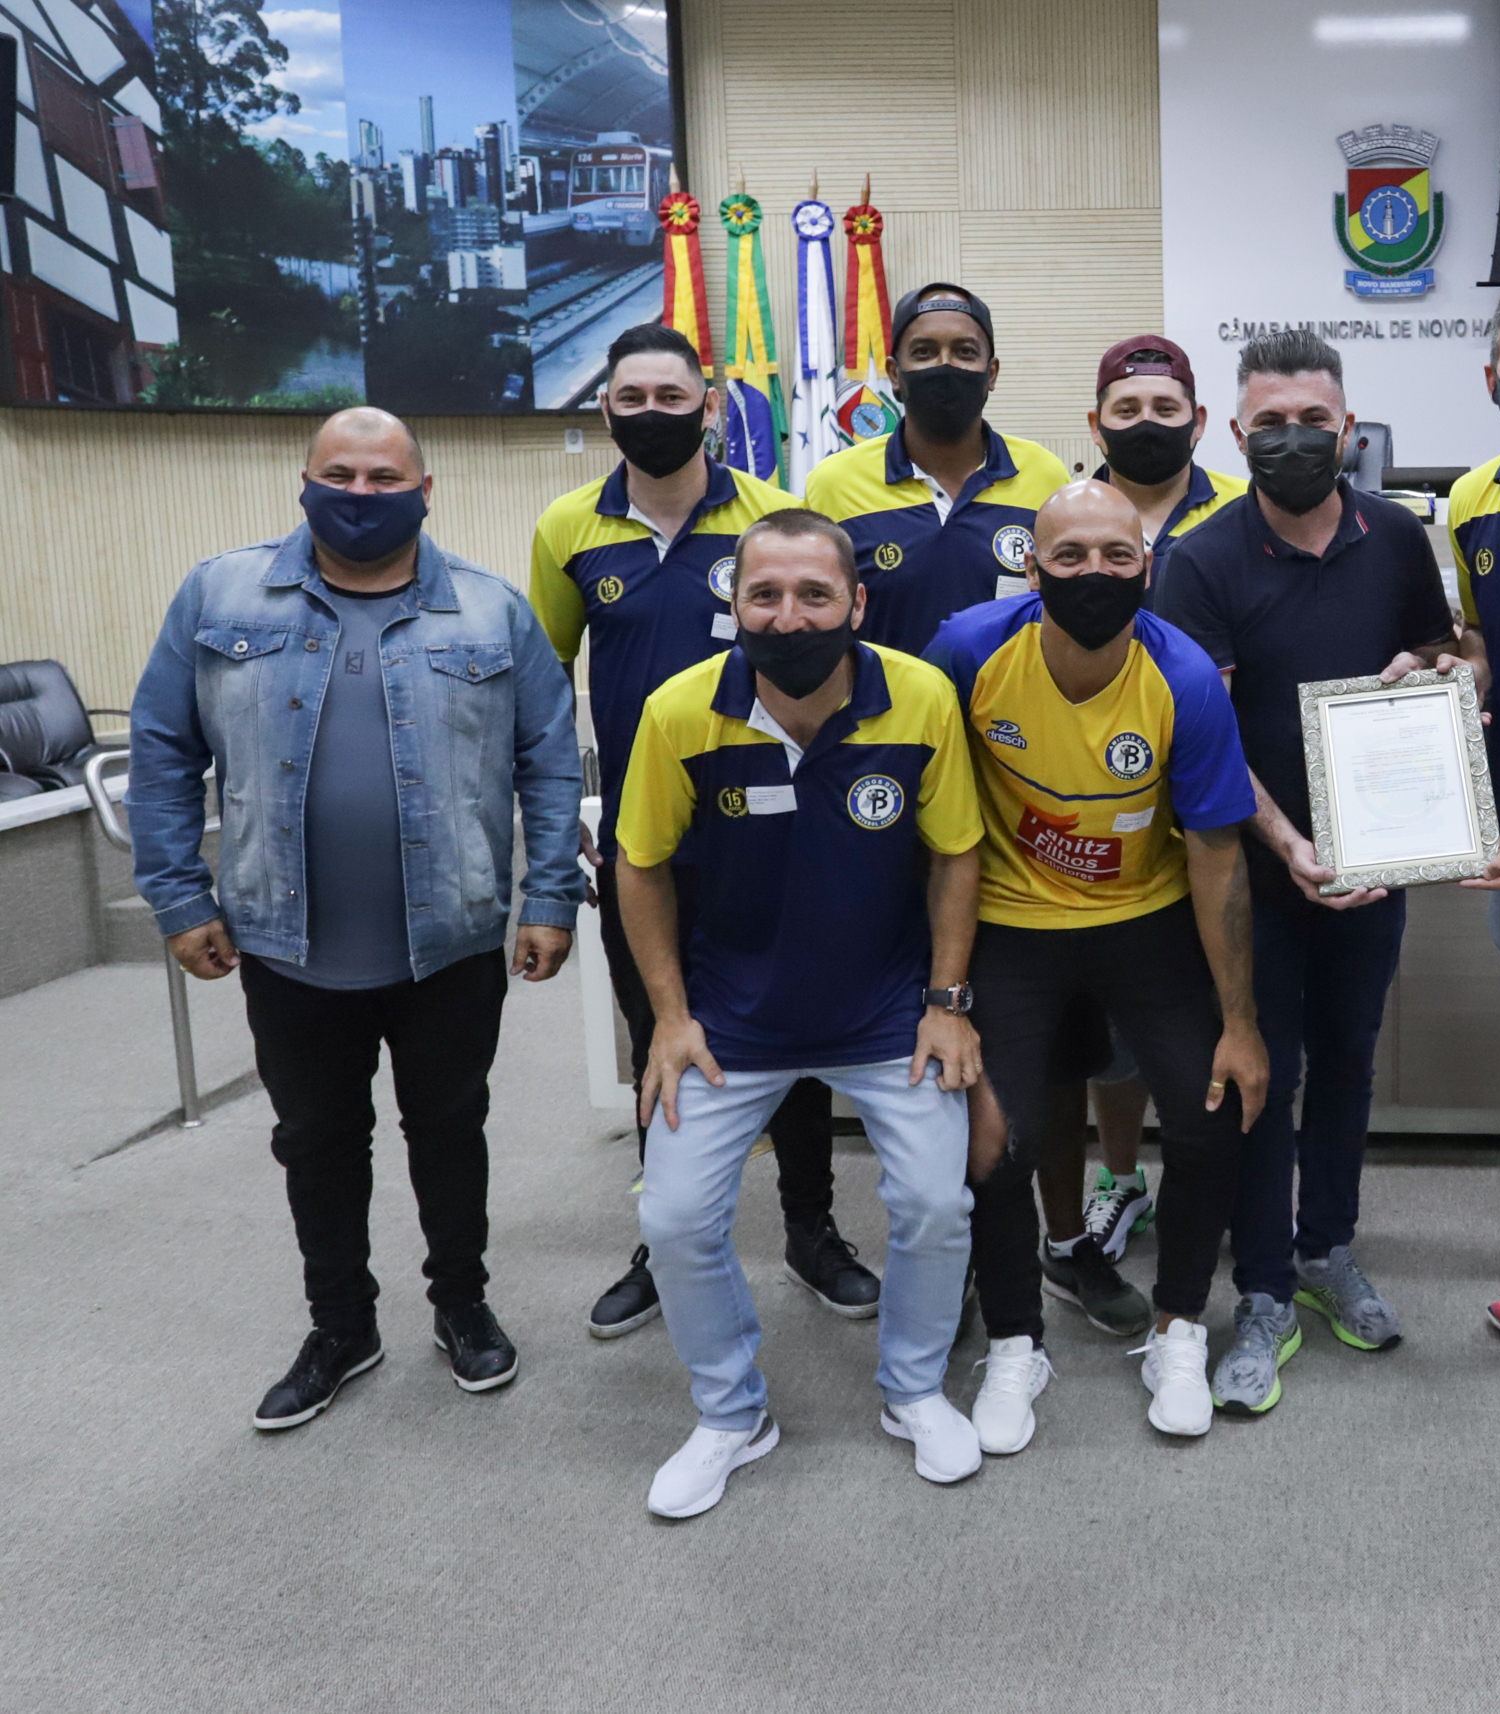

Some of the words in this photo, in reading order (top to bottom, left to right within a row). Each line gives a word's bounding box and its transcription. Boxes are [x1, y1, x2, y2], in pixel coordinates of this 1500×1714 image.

[1389, 320, 1412, 339] DE
[1418, 319, 1467, 338] NOVO
[882, 547, 895, 560] 15
[1480, 552, 1489, 565] 15
[603, 580, 615, 594] 15
[987, 730, 1026, 748] dresch
[725, 792, 741, 807] 15
[1034, 832, 1098, 869] Filhos
[1036, 851, 1095, 881] Extintores
